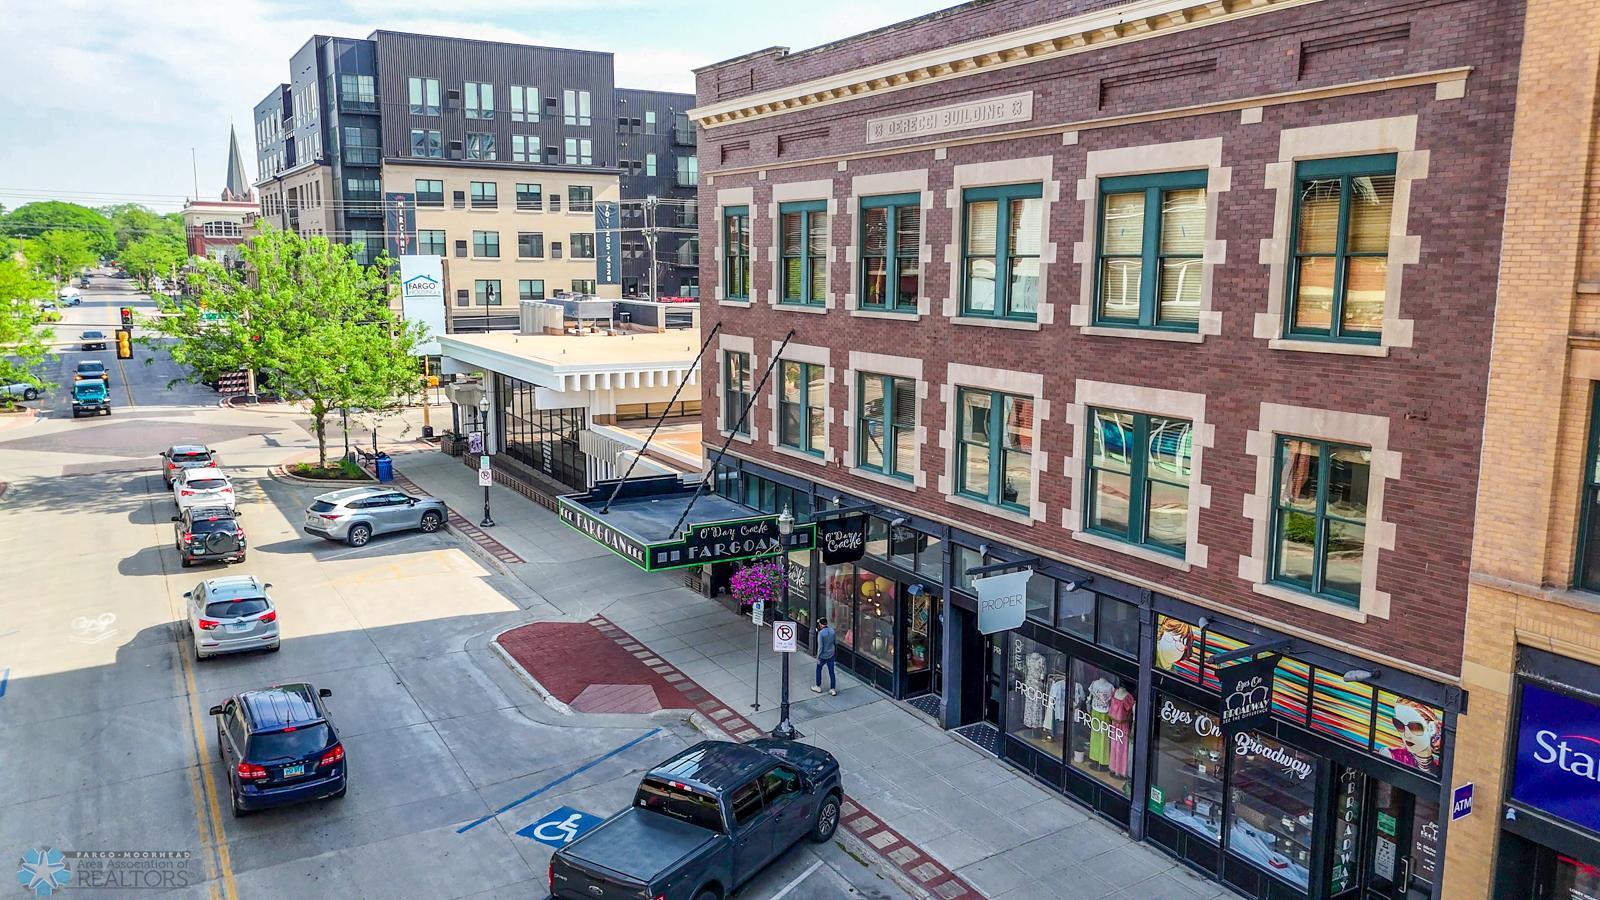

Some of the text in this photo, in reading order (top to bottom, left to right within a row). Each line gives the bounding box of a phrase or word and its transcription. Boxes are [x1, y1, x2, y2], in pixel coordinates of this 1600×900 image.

[943, 103, 1005, 126] BUILDING
[576, 512, 627, 554] FARGOAN
[700, 526, 735, 541] O'Day
[688, 537, 780, 559] FARGOAN
[981, 594, 1023, 613] PROPER
[1251, 676, 1262, 688] On
[1015, 680, 1057, 711] PROPER
[1160, 701, 1222, 737] Eyes On
[1223, 699, 1270, 719] BROADWAY
[1077, 710, 1124, 744] PROPER
[1234, 731, 1313, 780] Broadway
[1453, 796, 1472, 813] ATM
[1340, 782, 1355, 891] BROADWAY
